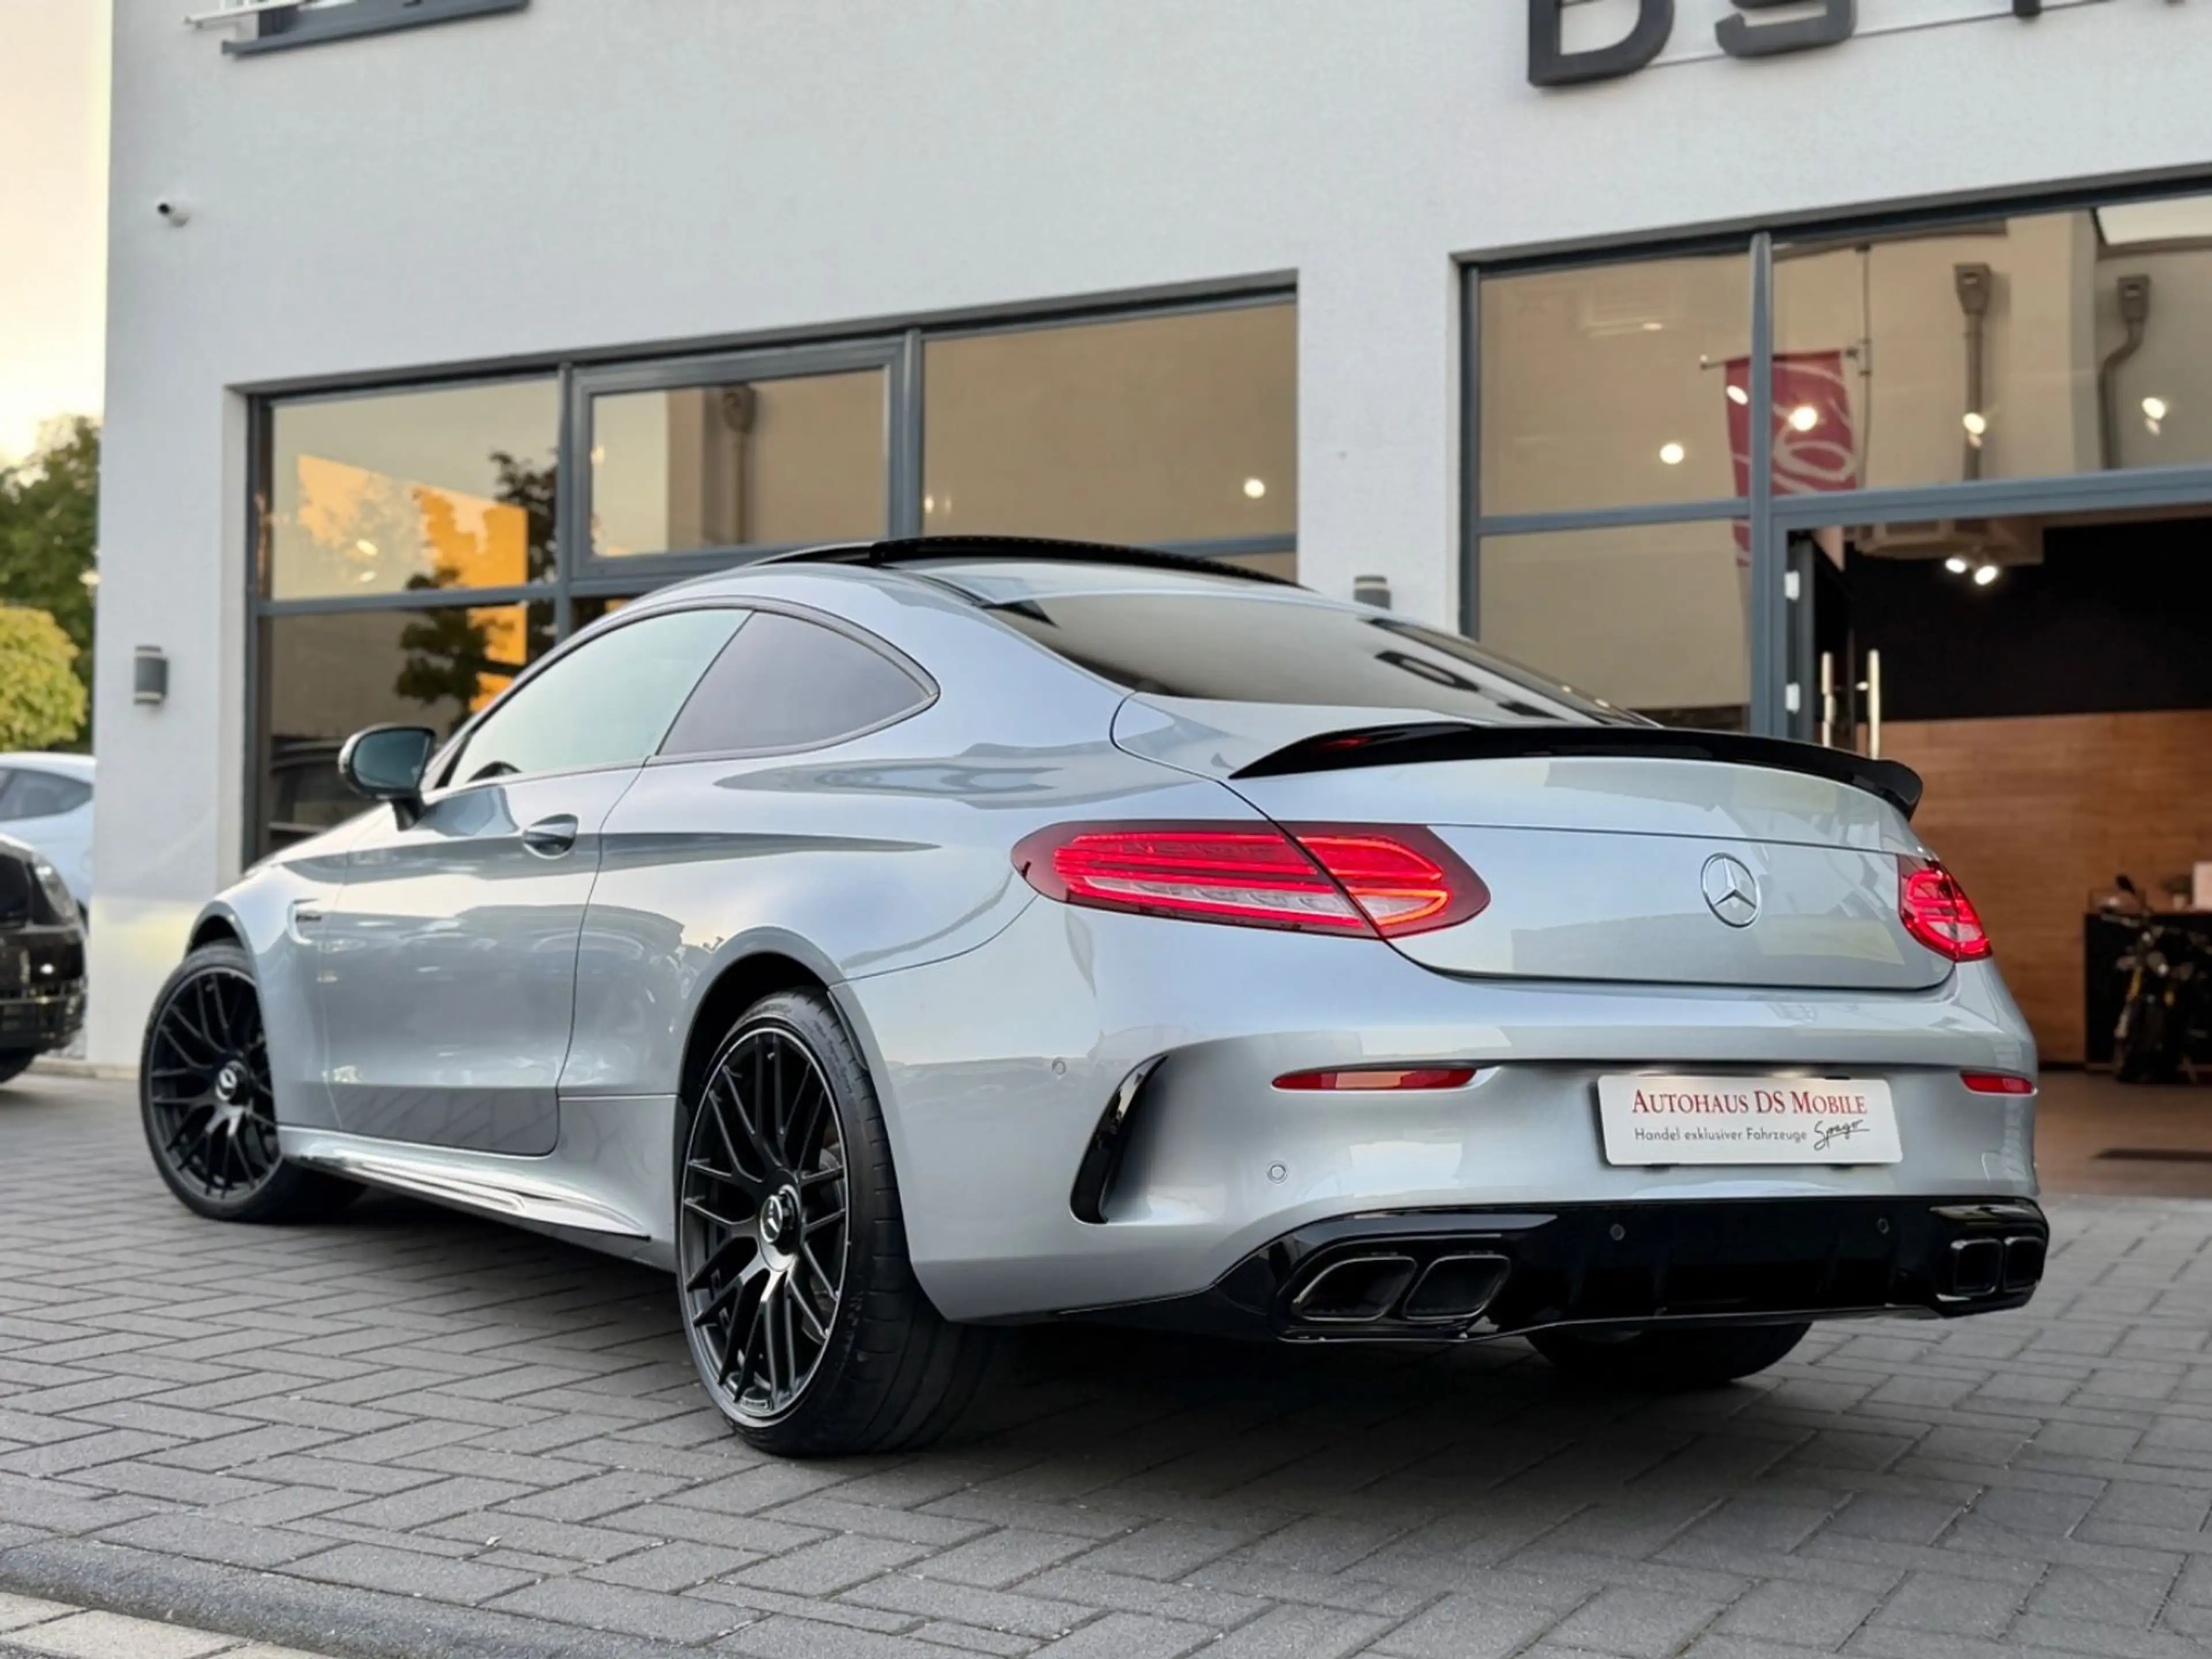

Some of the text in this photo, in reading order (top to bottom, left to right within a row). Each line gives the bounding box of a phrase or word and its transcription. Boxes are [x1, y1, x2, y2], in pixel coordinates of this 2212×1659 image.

[1632, 1089, 1868, 1114] AUTOHAUS DS MOBILE
[1634, 1127, 1680, 1141] Handel
[1684, 1127, 1742, 1141] exklusiver
[1746, 1127, 1807, 1143] Fahrzeuge
